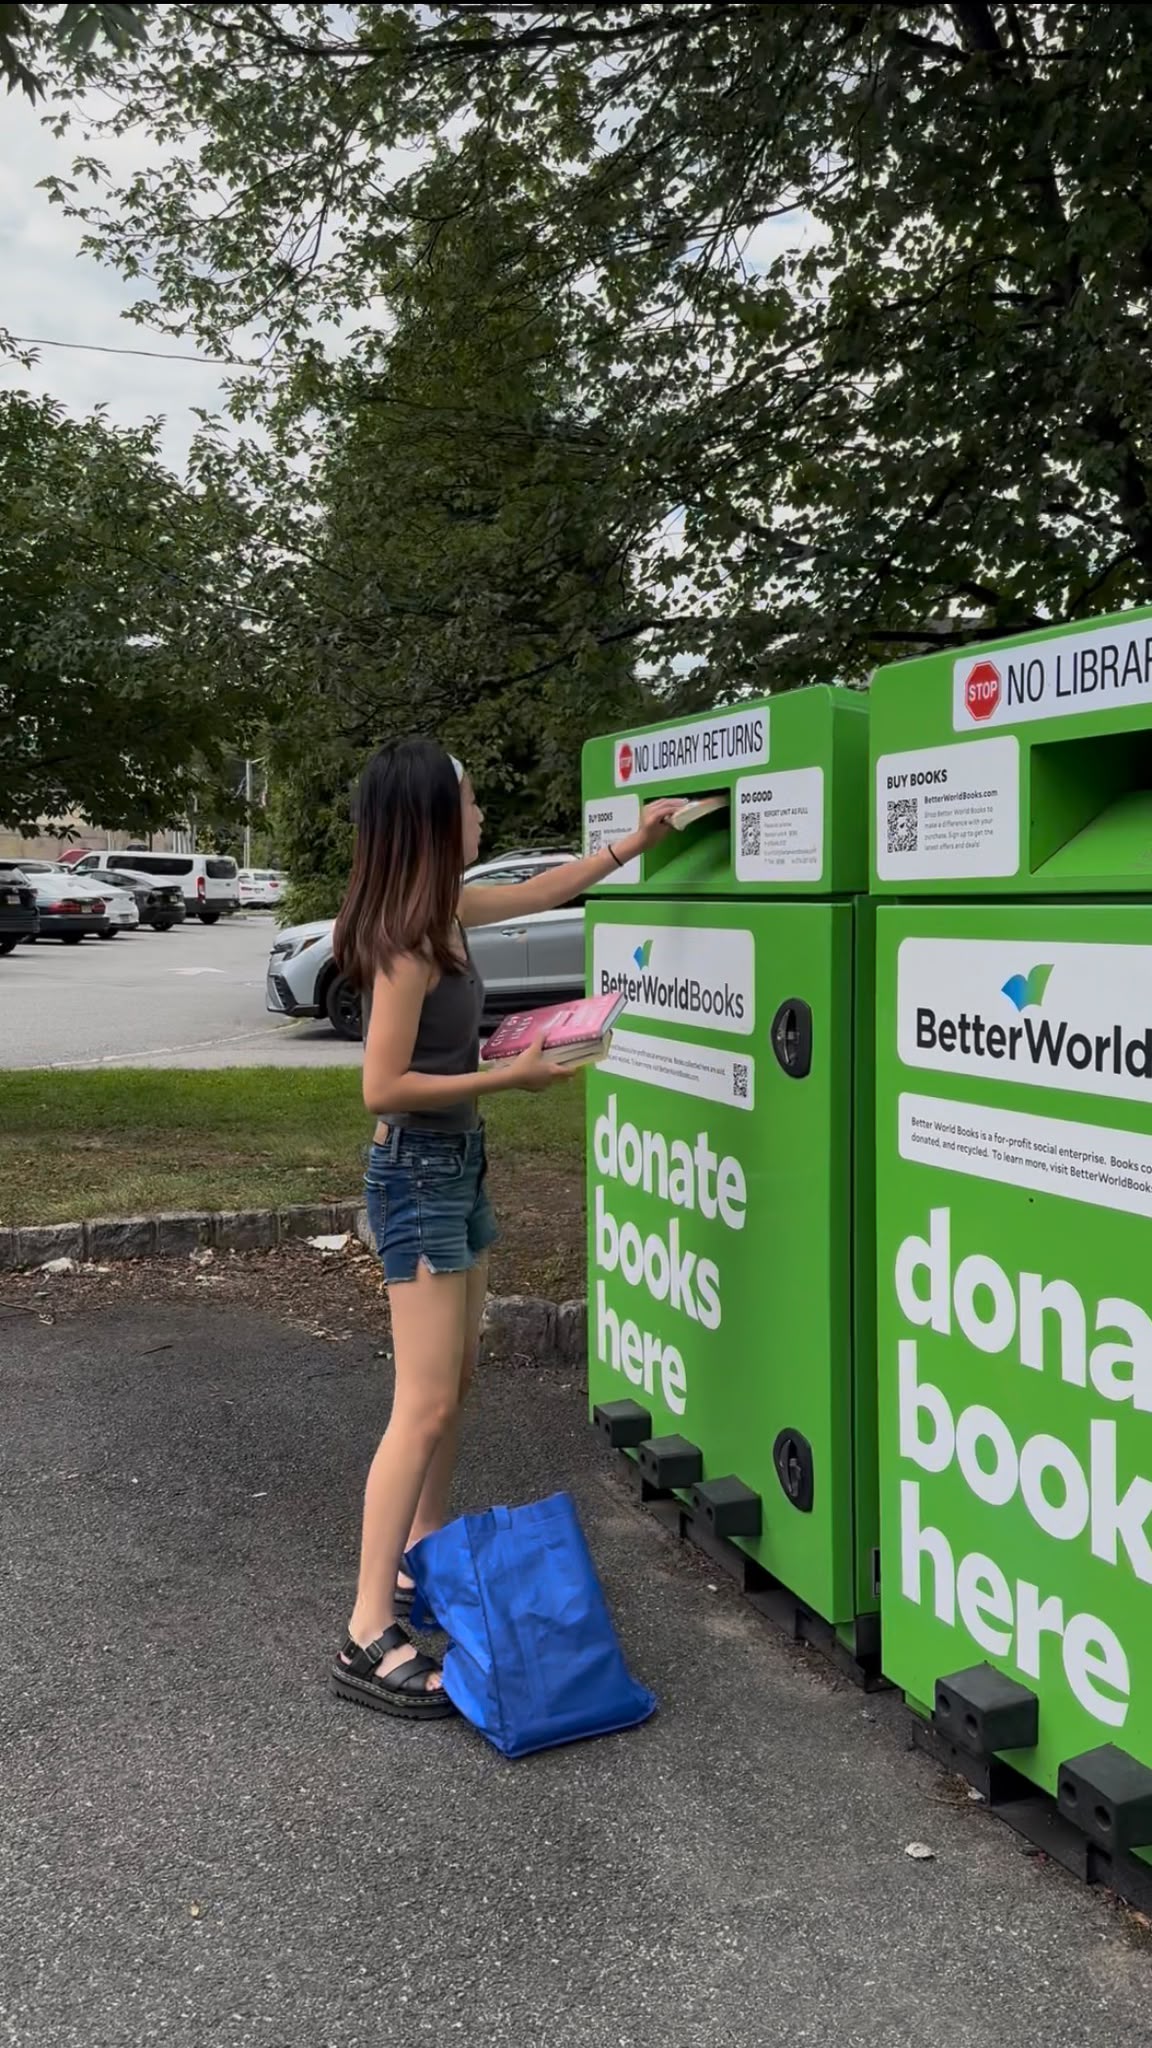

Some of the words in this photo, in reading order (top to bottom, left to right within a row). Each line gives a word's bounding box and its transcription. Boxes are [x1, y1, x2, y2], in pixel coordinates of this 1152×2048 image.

[968, 680, 998, 702] STOP
[1007, 659, 1045, 705] NO
[634, 745, 649, 773] NO
[652, 734, 699, 770] LIBRARY
[703, 720, 763, 761] RETURNS
[741, 792, 751, 804] DO
[752, 790, 773, 803] GOOD
[887, 774, 908, 789] BUY
[910, 769, 948, 786] BOOKS
[924, 789, 998, 804] BetterWorldBooks.com
[601, 970, 744, 1019] BetterWorldBooks
[916, 1007, 1152, 1079] BetterWorld
[594, 1093, 747, 1230] donate
[911, 1117, 932, 1129] Better
[934, 1121, 956, 1134] World
[957, 1125, 979, 1139] Books
[980, 1130, 986, 1140] is
[994, 1132, 1031, 1150] for-profit
[1033, 1142, 1057, 1155] social
[1058, 1147, 1107, 1165] enterprise.
[1110, 1155, 1139, 1171] Books
[911, 1132, 941, 1148] donated,
[942, 1141, 956, 1150] and
[957, 1143, 989, 1157] recycled.
[992, 1149, 1002, 1160] To
[1003, 1152, 1024, 1165] learn
[1025, 1158, 1048, 1172] more,
[1049, 1162, 1068, 1176] visit
[595, 1185, 721, 1330] books
[895, 1207, 1152, 1413] dona
[597, 1279, 687, 1415] here
[898, 1339, 1152, 1584] book
[900, 1480, 1130, 1727] here
